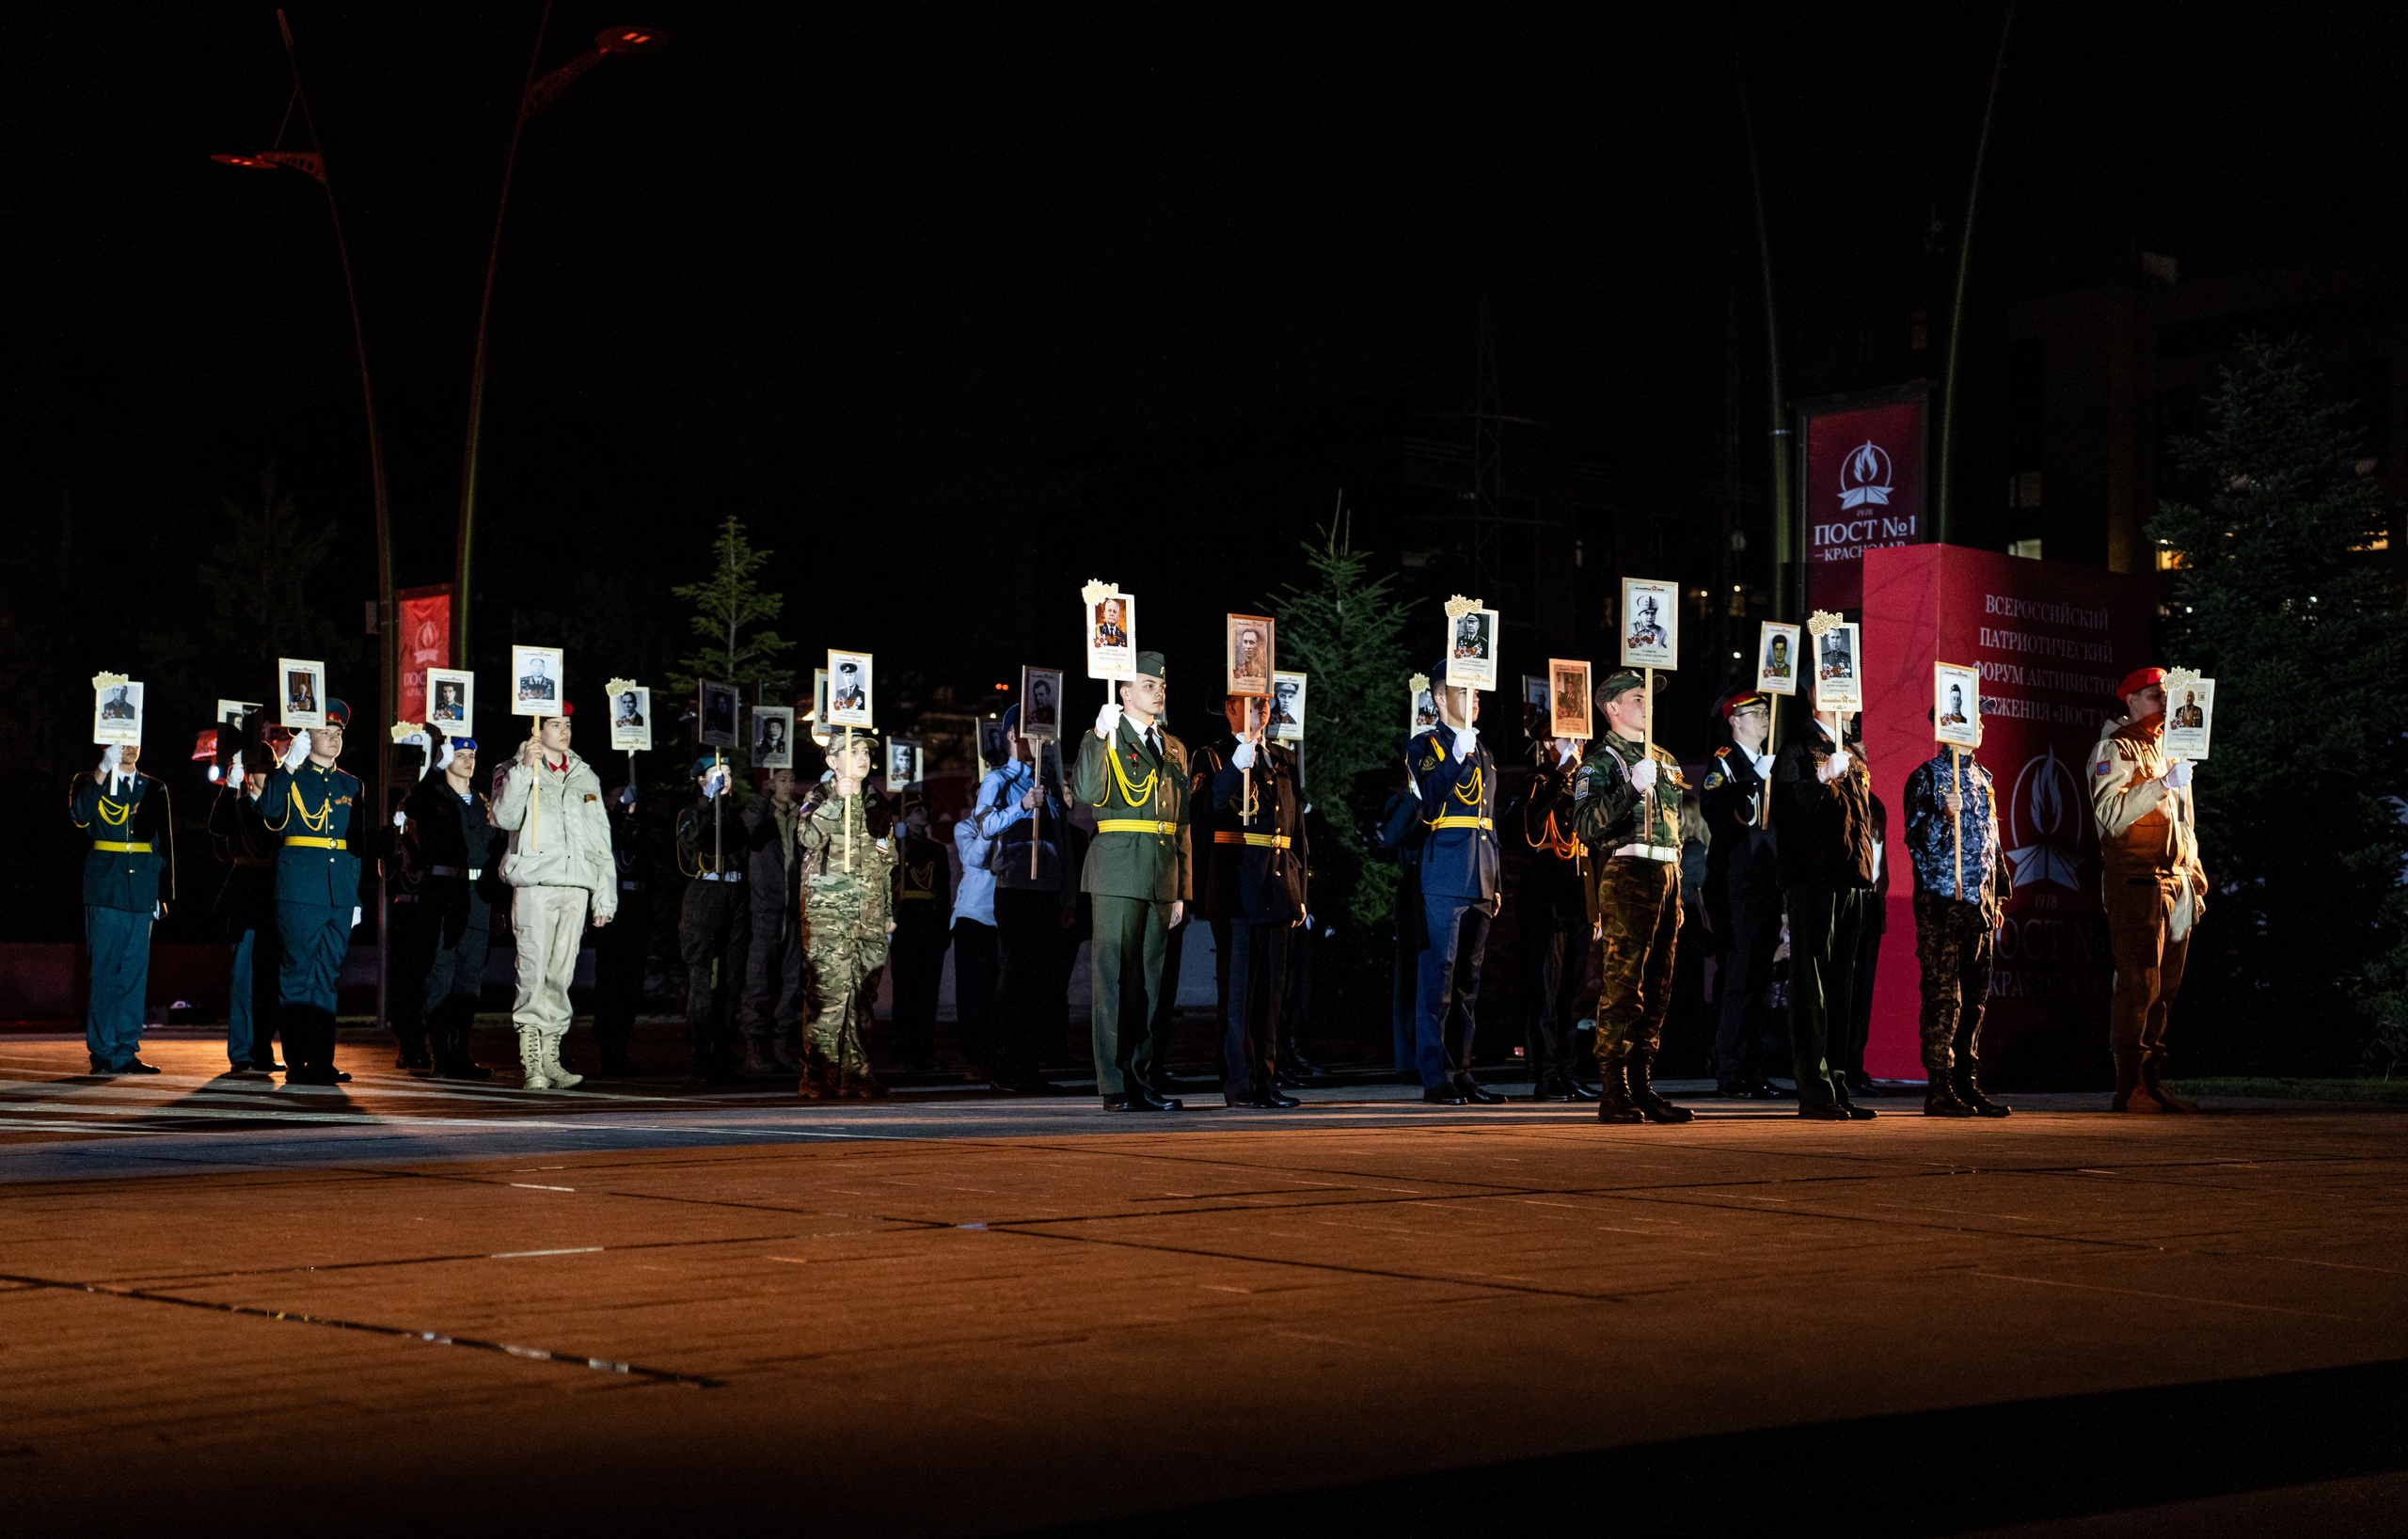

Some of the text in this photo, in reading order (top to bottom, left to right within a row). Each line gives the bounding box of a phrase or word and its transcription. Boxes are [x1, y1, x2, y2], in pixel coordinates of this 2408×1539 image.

[1814, 515, 1916, 546] ПОСТ №1
[1825, 541, 1906, 562] КРАСН
[1986, 594, 2109, 630] ВСЕРОССИЙСКИЙ
[1980, 627, 2114, 663] ПАТРИОТИЧЕСКИЙ
[404, 671, 427, 687] ПОС
[1972, 660, 2024, 685] ФОРУМ
[2035, 894, 2058, 909] 1978
[1995, 917, 2064, 960] ОСТ
